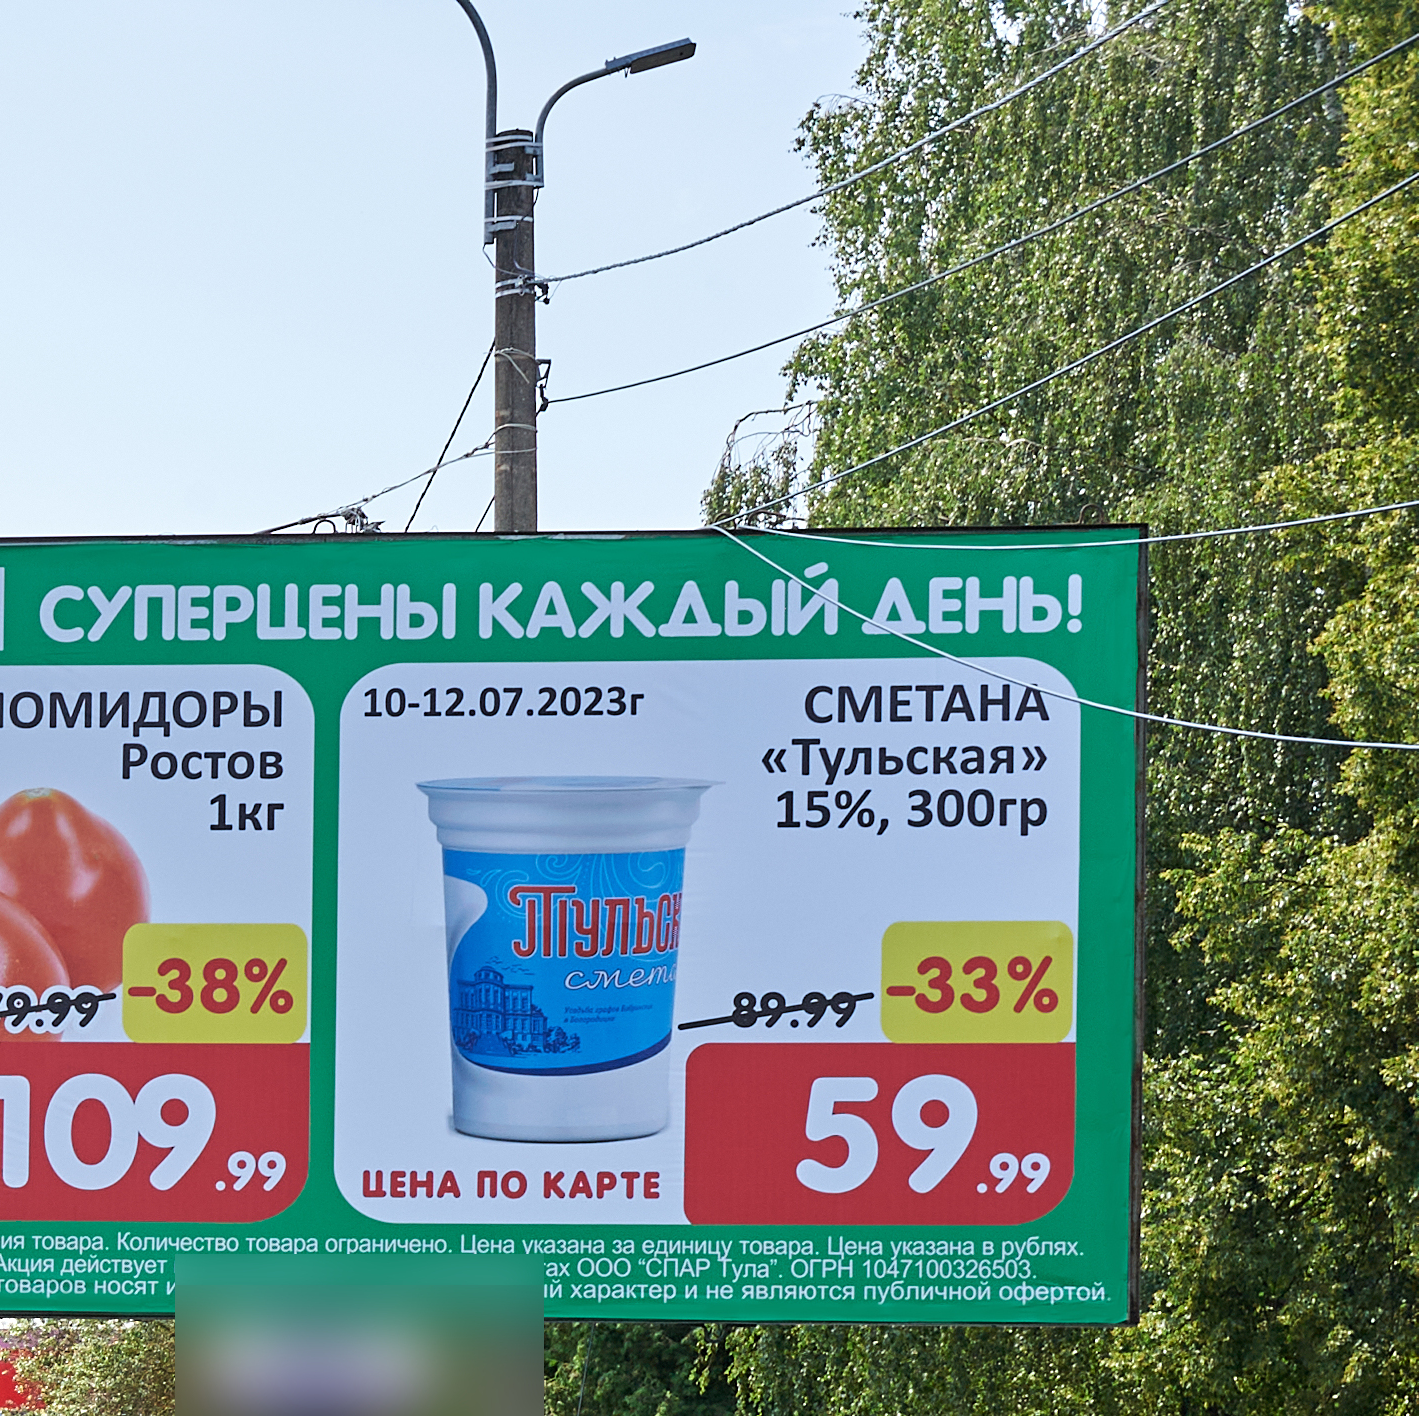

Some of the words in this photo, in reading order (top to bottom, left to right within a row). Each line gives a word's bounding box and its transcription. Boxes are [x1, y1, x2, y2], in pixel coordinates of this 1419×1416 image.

[39, 582, 456, 643] СУПЕРЦЕНЫ
[478, 562, 839, 639] КАЖДЫЙ
[861, 573, 1082, 635] ДЕНЬ!
[363, 686, 645, 719] 10-12.07.2023г
[804, 683, 1050, 724] СМЕТАНА
[121, 743, 284, 780] Ростов
[760, 738, 1048, 785] «Тульская»
[209, 793, 284, 831] 1кг
[776, 789, 890, 837] 15%,
[906, 789, 1048, 837] 300гр
[126, 956, 294, 1015] -38%
[886, 955, 1059, 1016] -33%
[732, 990, 857, 1029] 89.99
[362, 1169, 462, 1201] ЦЕНА
[476, 1169, 528, 1200] ПО
[544, 1169, 661, 1200] КАРТЕ
[31, 1236, 109, 1255] товара.
[116, 1232, 240, 1252] Количество
[245, 1237, 318, 1254] товара
[325, 1237, 453, 1254] ограничено.
[460, 1234, 514, 1254] Цена
[521, 1238, 605, 1254] указана
[611, 1239, 635, 1254] за
[641, 1239, 733, 1259] единицу
[739, 1239, 820, 1258] товара.
[827, 1236, 883, 1258] Цена
[889, 1240, 975, 1260] указана
[982, 1240, 995, 1256] в
[1001, 1236, 1085, 1260] рублях.
[60, 1255, 168, 1277] действует
[576, 1257, 632, 1278] ООО
[790, 1259, 854, 1279] ОГРН
[863, 1259, 1037, 1279] 1047100326503.
[93, 1280, 158, 1295] носят
[570, 1283, 677, 1302] характер
[684, 1284, 698, 1299] и
[706, 1284, 734, 1300] не
[741, 1284, 856, 1301] являются
[863, 1281, 991, 1304] публичной
[998, 1281, 1112, 1305] офертой.
